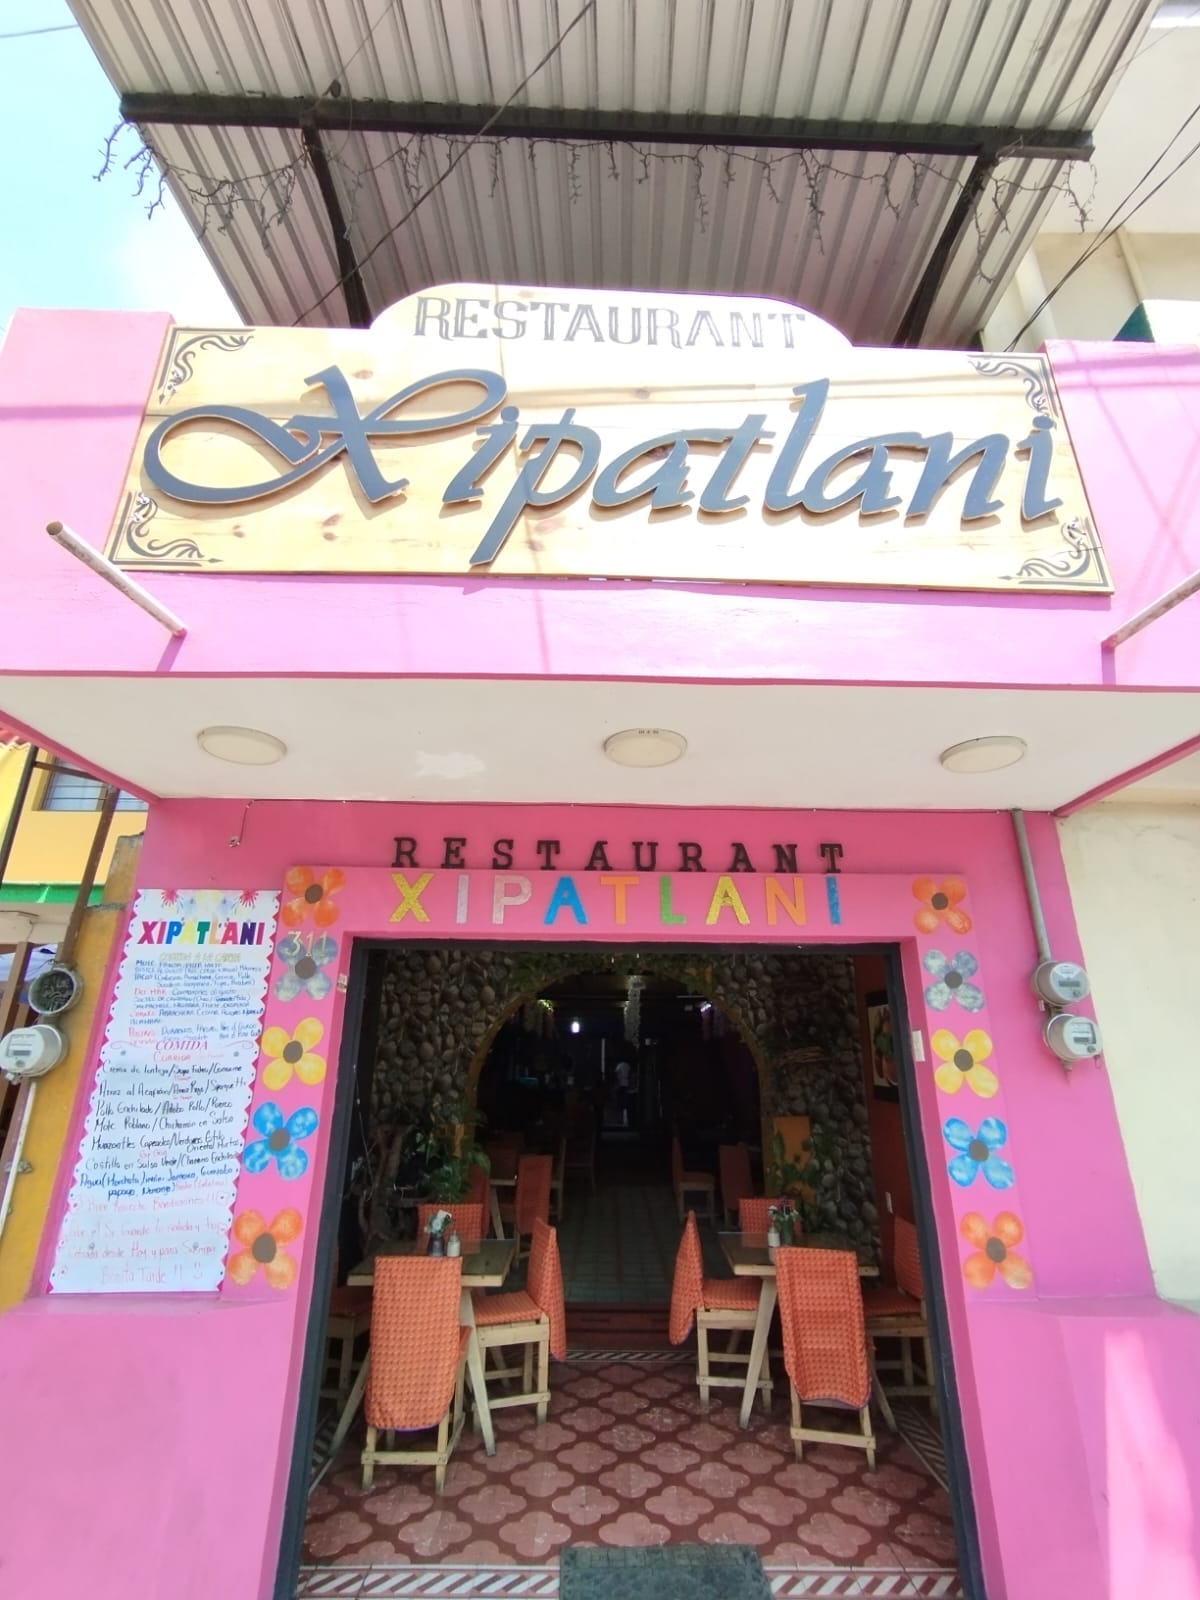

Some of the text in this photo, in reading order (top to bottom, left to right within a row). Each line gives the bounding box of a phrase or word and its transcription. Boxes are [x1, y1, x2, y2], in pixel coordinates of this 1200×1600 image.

[413, 296, 807, 349] RESTAURANT
[143, 365, 1065, 567] Xipatlani
[391, 836, 845, 874] RESTAURANT
[389, 872, 841, 927] XIPATLANI
[137, 921, 265, 945] XIPATLANI
[284, 931, 328, 957] 311
[155, 1039, 208, 1051] COMIDA
